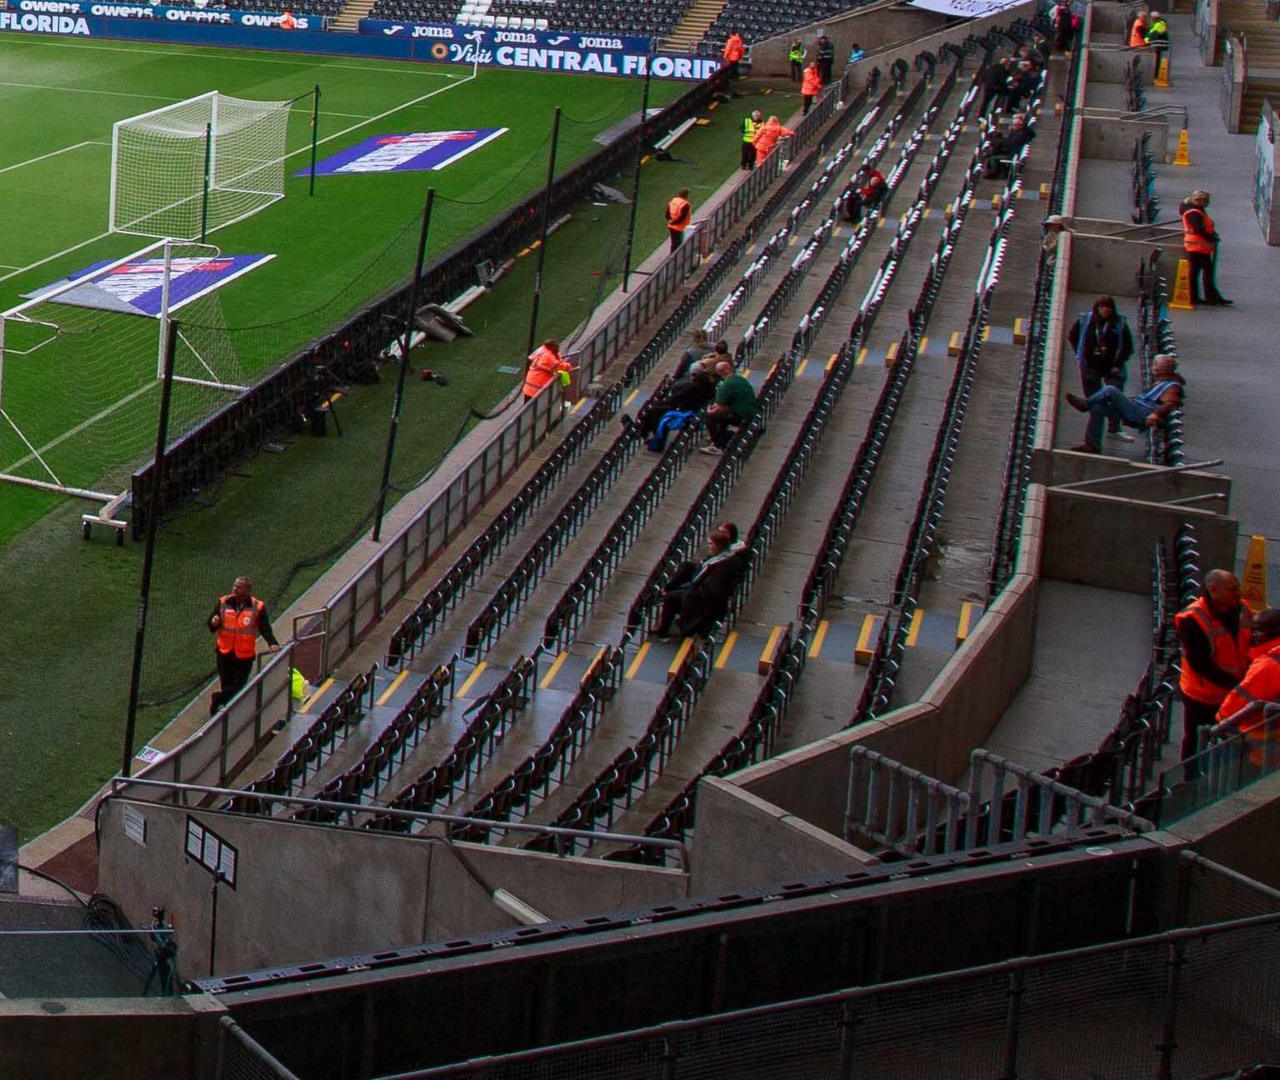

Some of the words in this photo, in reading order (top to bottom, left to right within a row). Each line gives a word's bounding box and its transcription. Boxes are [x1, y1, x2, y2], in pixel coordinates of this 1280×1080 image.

[0, 11, 90, 35] FLORIDA
[411, 23, 454, 39] joma
[493, 29, 537, 44] joma
[578, 35, 623, 51] joma
[450, 43, 492, 64] Visit
[496, 45, 618, 74] CENTRAL
